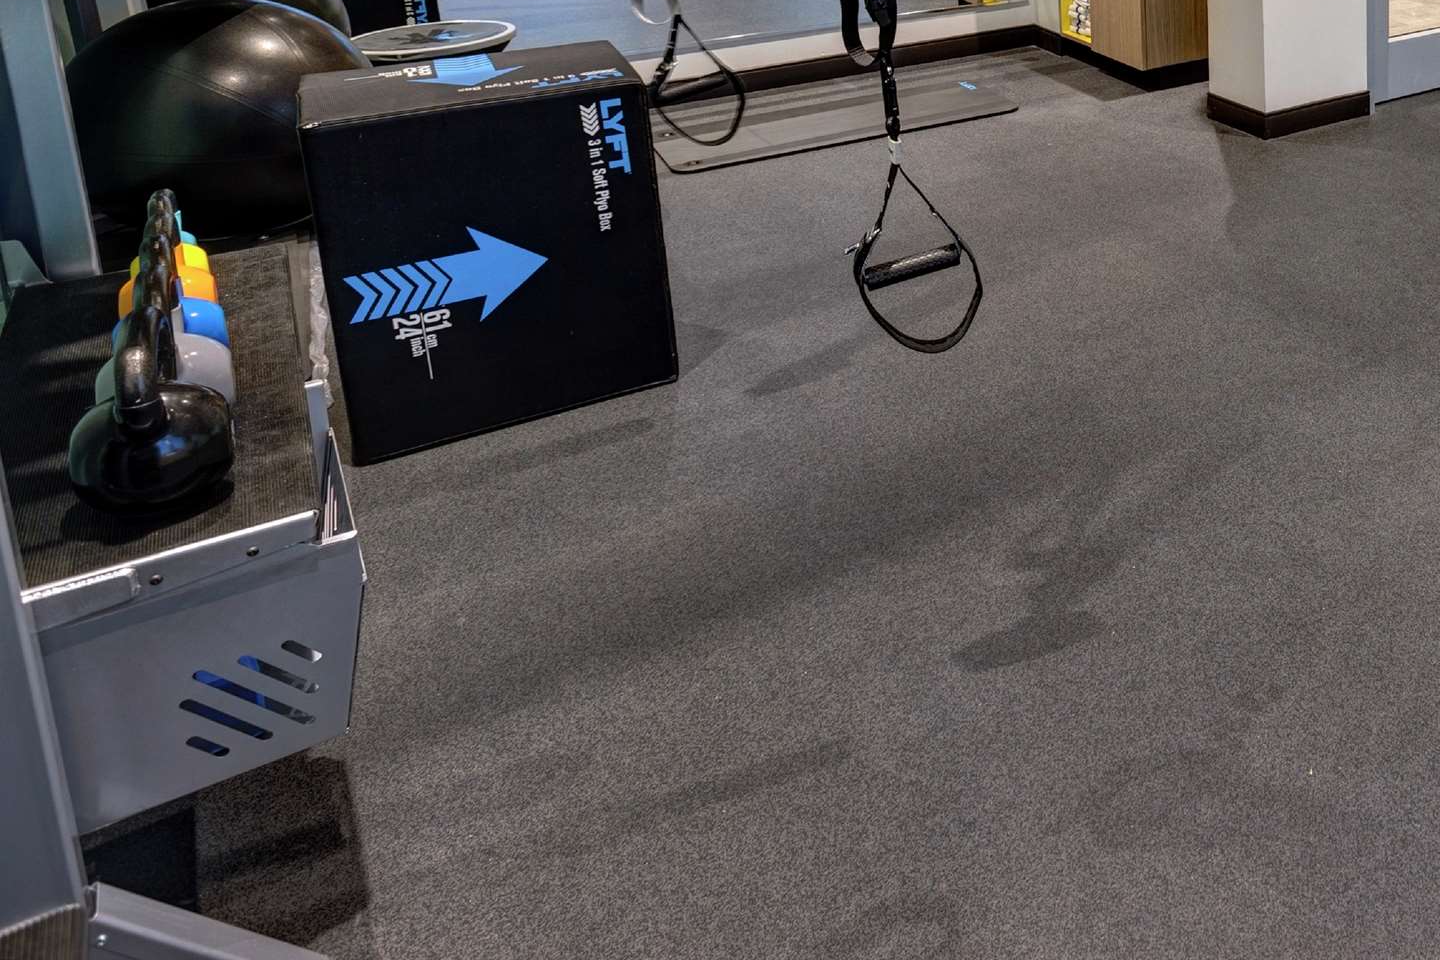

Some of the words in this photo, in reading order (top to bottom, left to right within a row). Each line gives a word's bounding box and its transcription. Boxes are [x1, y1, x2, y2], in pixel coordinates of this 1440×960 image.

[588, 138, 602, 147] 3
[600, 97, 632, 174] LYFT
[589, 147, 604, 159] in
[592, 167, 609, 189] Soft
[593, 189, 611, 211] Plyo
[598, 211, 614, 232] Box
[423, 308, 453, 333] 61
[392, 313, 423, 341] 24
[410, 336, 426, 358] inch
[426, 334, 439, 349] cm
